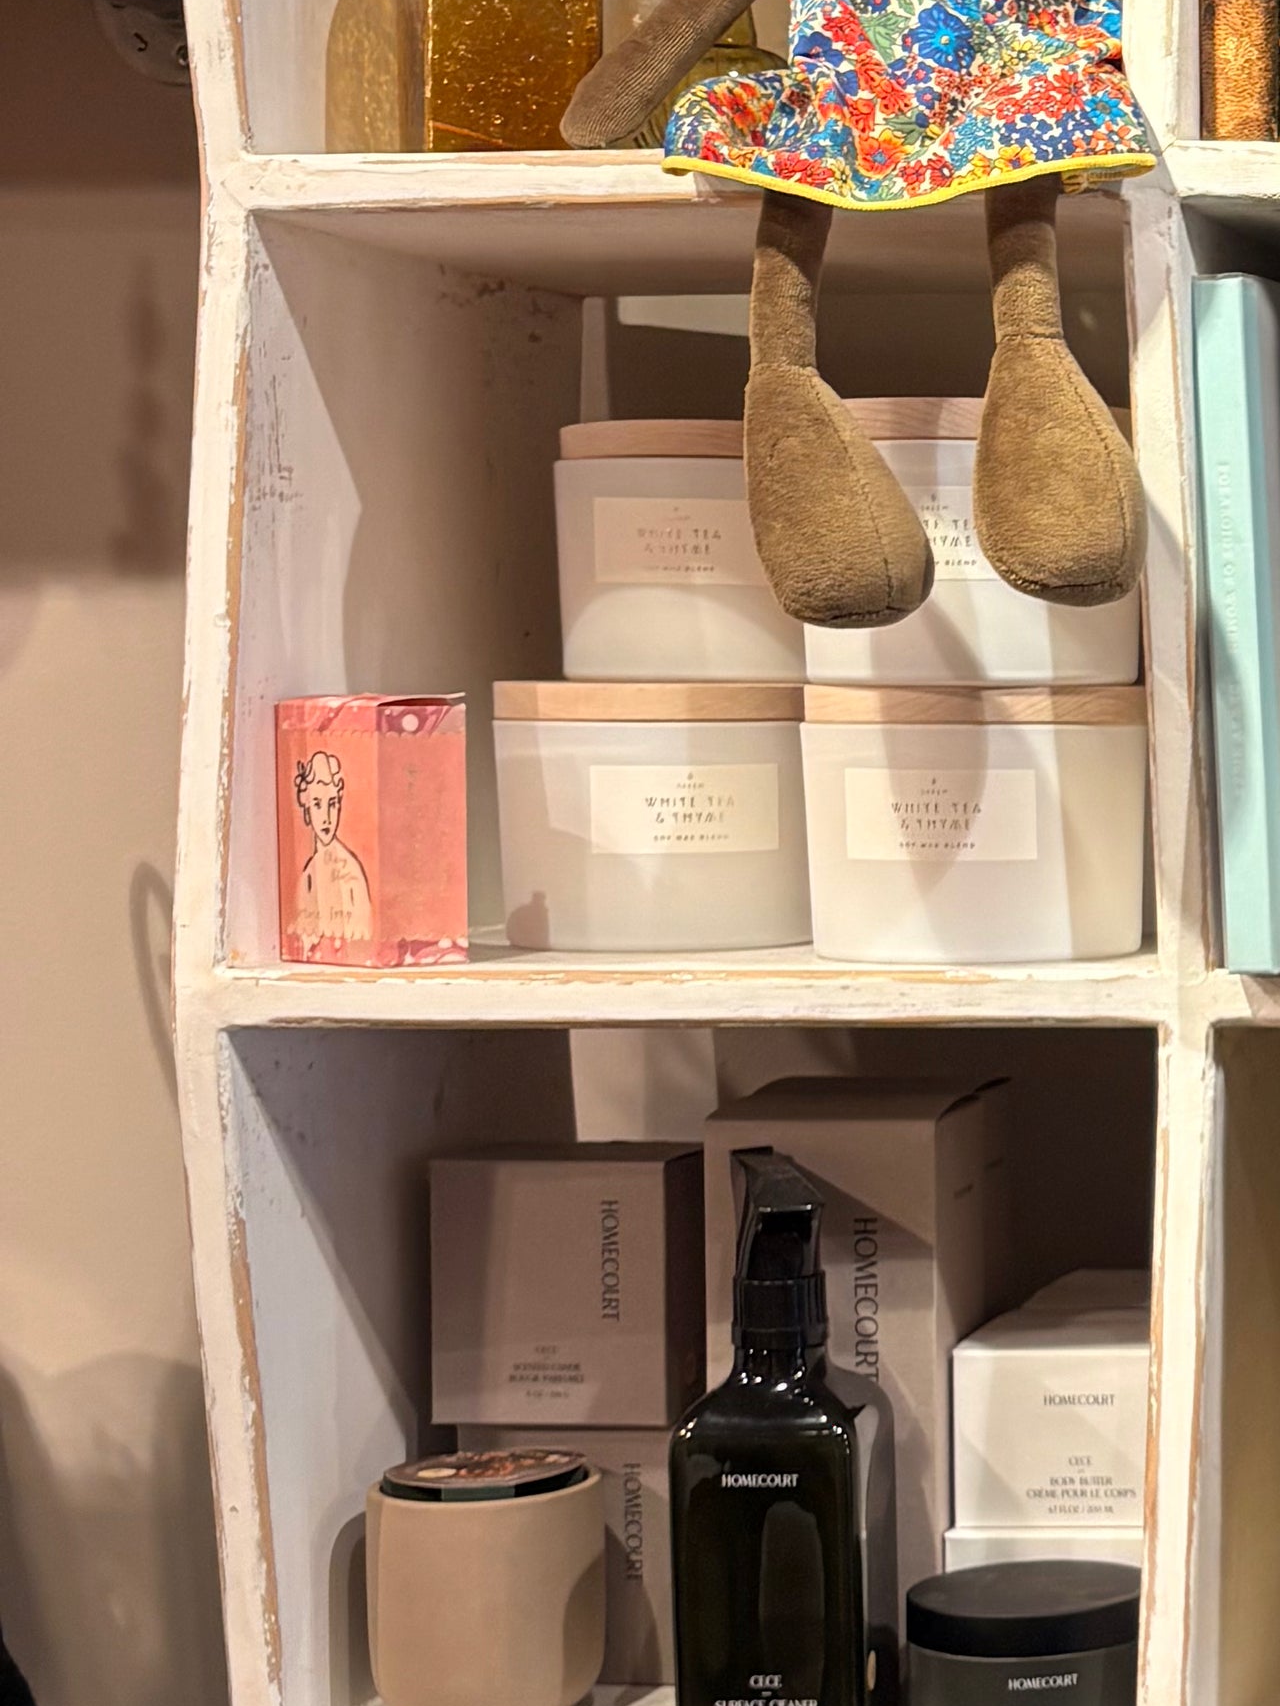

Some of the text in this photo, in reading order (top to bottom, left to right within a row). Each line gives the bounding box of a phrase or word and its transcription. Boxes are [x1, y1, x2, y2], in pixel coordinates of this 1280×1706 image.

[644, 795, 735, 808] WHITE TEA
[950, 802, 982, 814] TEA
[601, 1199, 620, 1322] HOMECOURT
[854, 1216, 880, 1383] HOMECOURT
[1043, 1394, 1115, 1406] HOMECOURT
[721, 1473, 799, 1488] HOMECOURT
[623, 1462, 644, 1581] HOMECOURT
[1008, 1673, 1078, 1691] HOMECOURT
